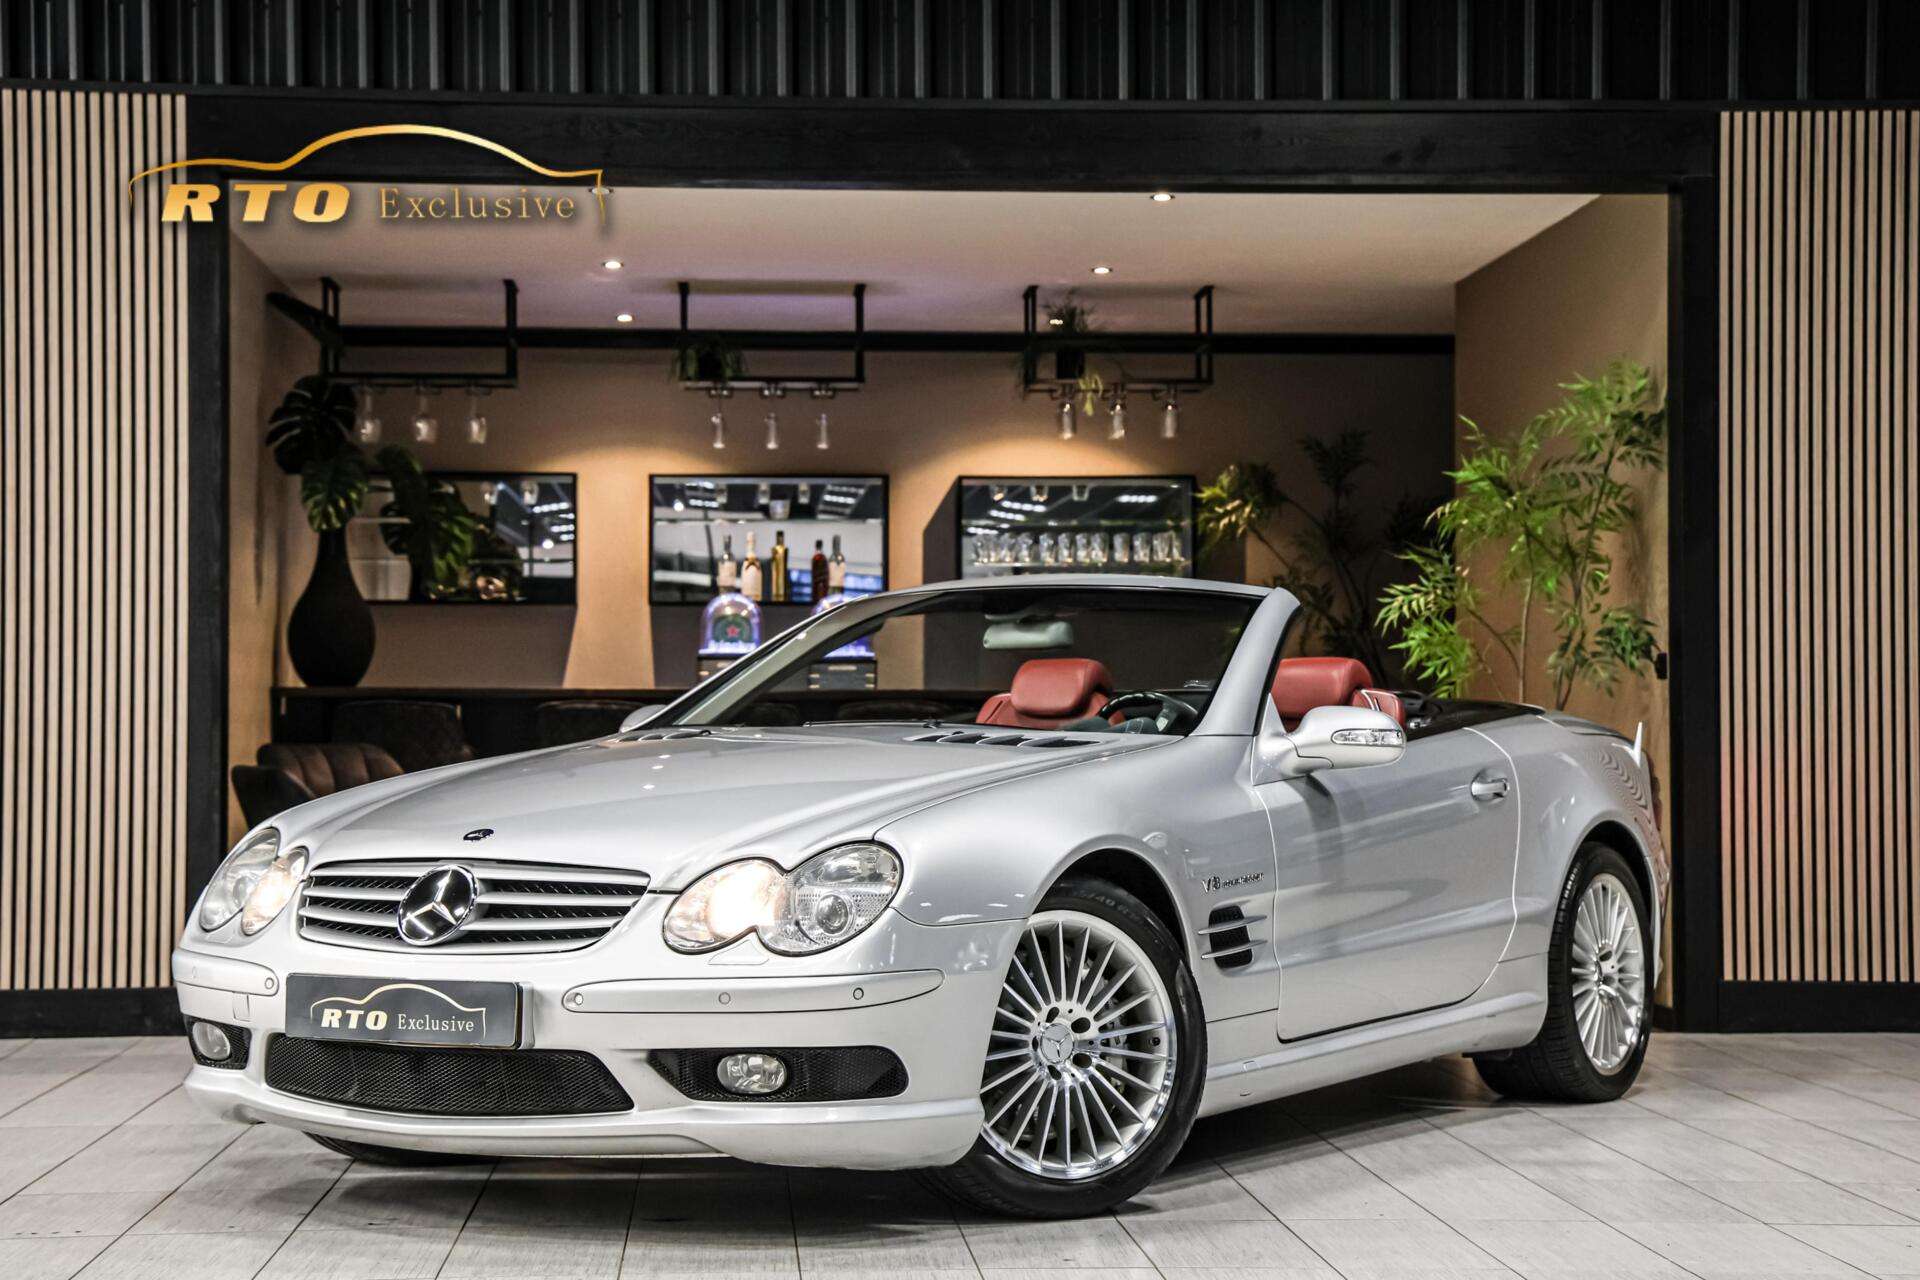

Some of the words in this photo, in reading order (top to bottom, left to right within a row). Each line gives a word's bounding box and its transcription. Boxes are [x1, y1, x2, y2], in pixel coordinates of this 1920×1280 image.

[1202, 876, 1221, 893] V8
[320, 1008, 388, 1031] RTO
[398, 1013, 475, 1032] Exclusive
